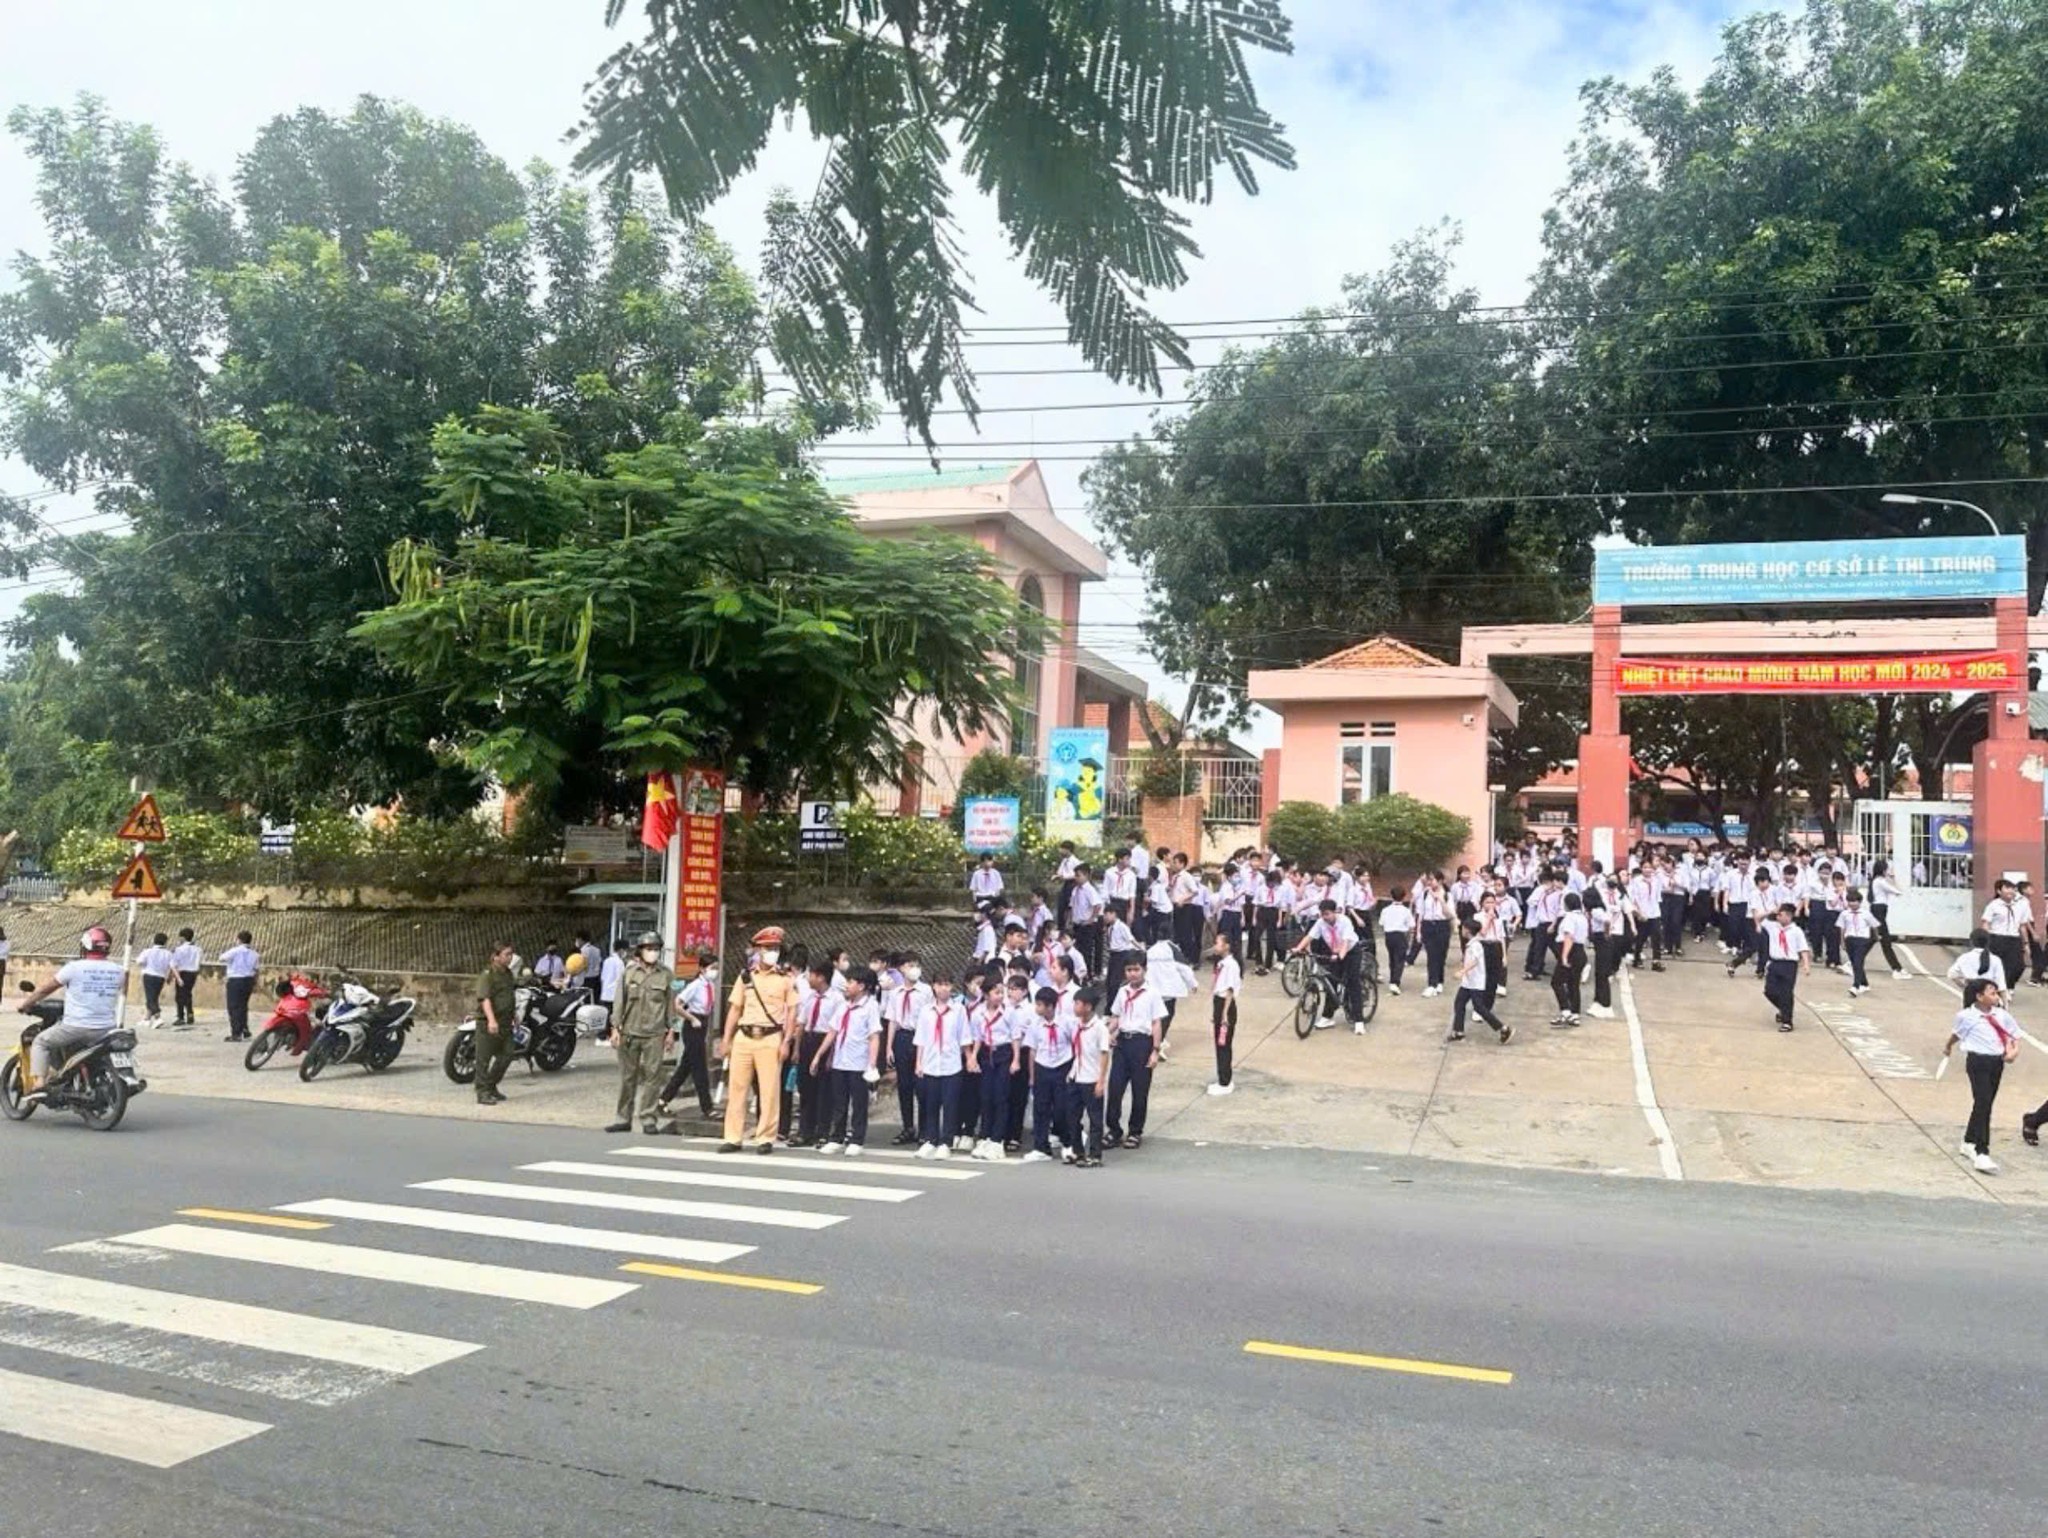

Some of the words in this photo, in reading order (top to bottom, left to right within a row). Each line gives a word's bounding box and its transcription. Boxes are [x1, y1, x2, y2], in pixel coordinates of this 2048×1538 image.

[1623, 561, 1692, 582] TRƯỜNG
[1697, 562, 1758, 580] TRUNG
[1763, 561, 1799, 582] HỌC
[1805, 558, 1831, 577] CƠ
[1837, 554, 1864, 576] SỞ
[1867, 555, 1890, 575] LÊ
[1895, 556, 1925, 578] THỊ
[1622, 666, 1664, 686] NHIỆT
[1669, 666, 1697, 686] LIỆT
[1703, 665, 1743, 683] CHÀO
[1748, 664, 1793, 683] MỪNG
[1799, 663, 1835, 683] NĂM
[1839, 665, 1871, 684] HỌC
[1875, 661, 1906, 682] MỚI
[1912, 662, 1951, 681] 2024
[1967, 662, 2008, 680] 2025
